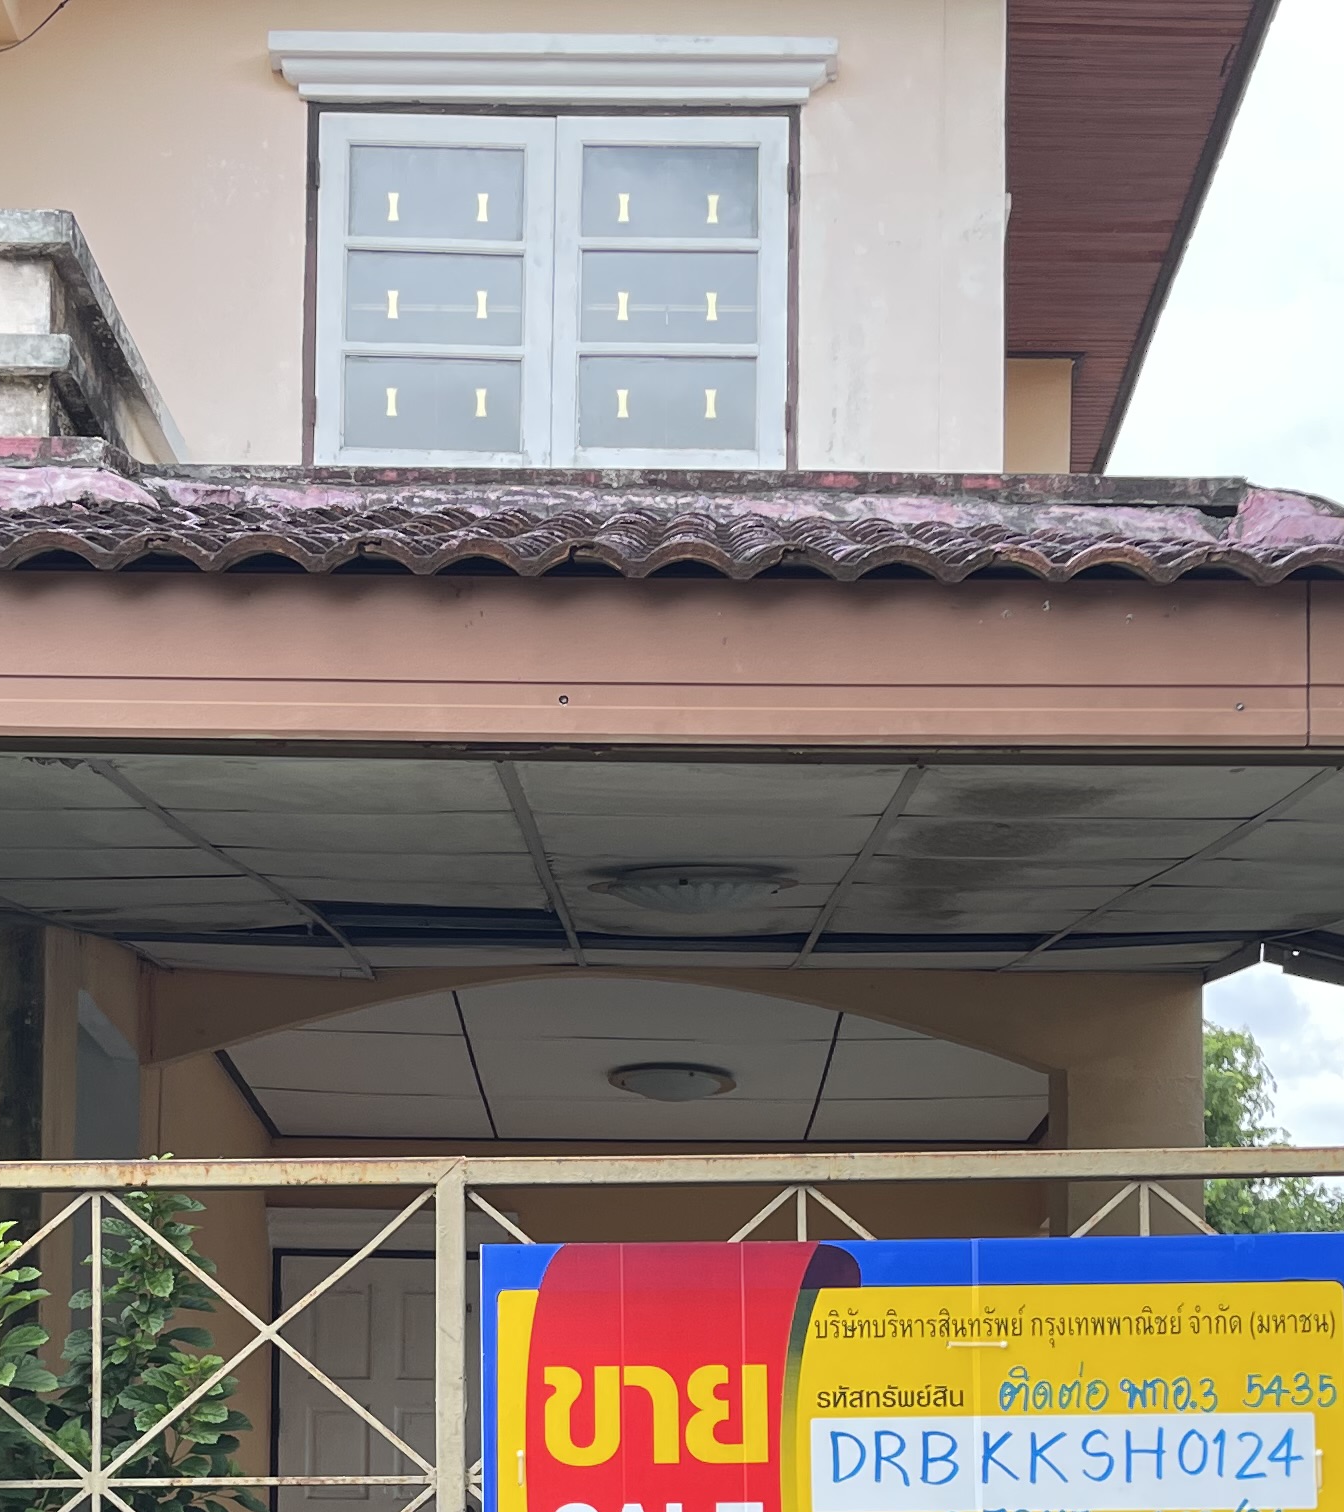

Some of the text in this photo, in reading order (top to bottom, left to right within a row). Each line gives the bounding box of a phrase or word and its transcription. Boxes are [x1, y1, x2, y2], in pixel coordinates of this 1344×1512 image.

[814, 1302, 1336, 1348] บริษัทบริหารสินทรัพย์ กรุงเทพพาณิชย์ จำกัด (มหาชน)
[816, 1384, 965, 1409] รหัสทรัพย์สิน
[999, 1361, 1109, 1412] ติดต่อ
[1242, 1371, 1338, 1408] 5435
[544, 1364, 769, 1467] ขาย
